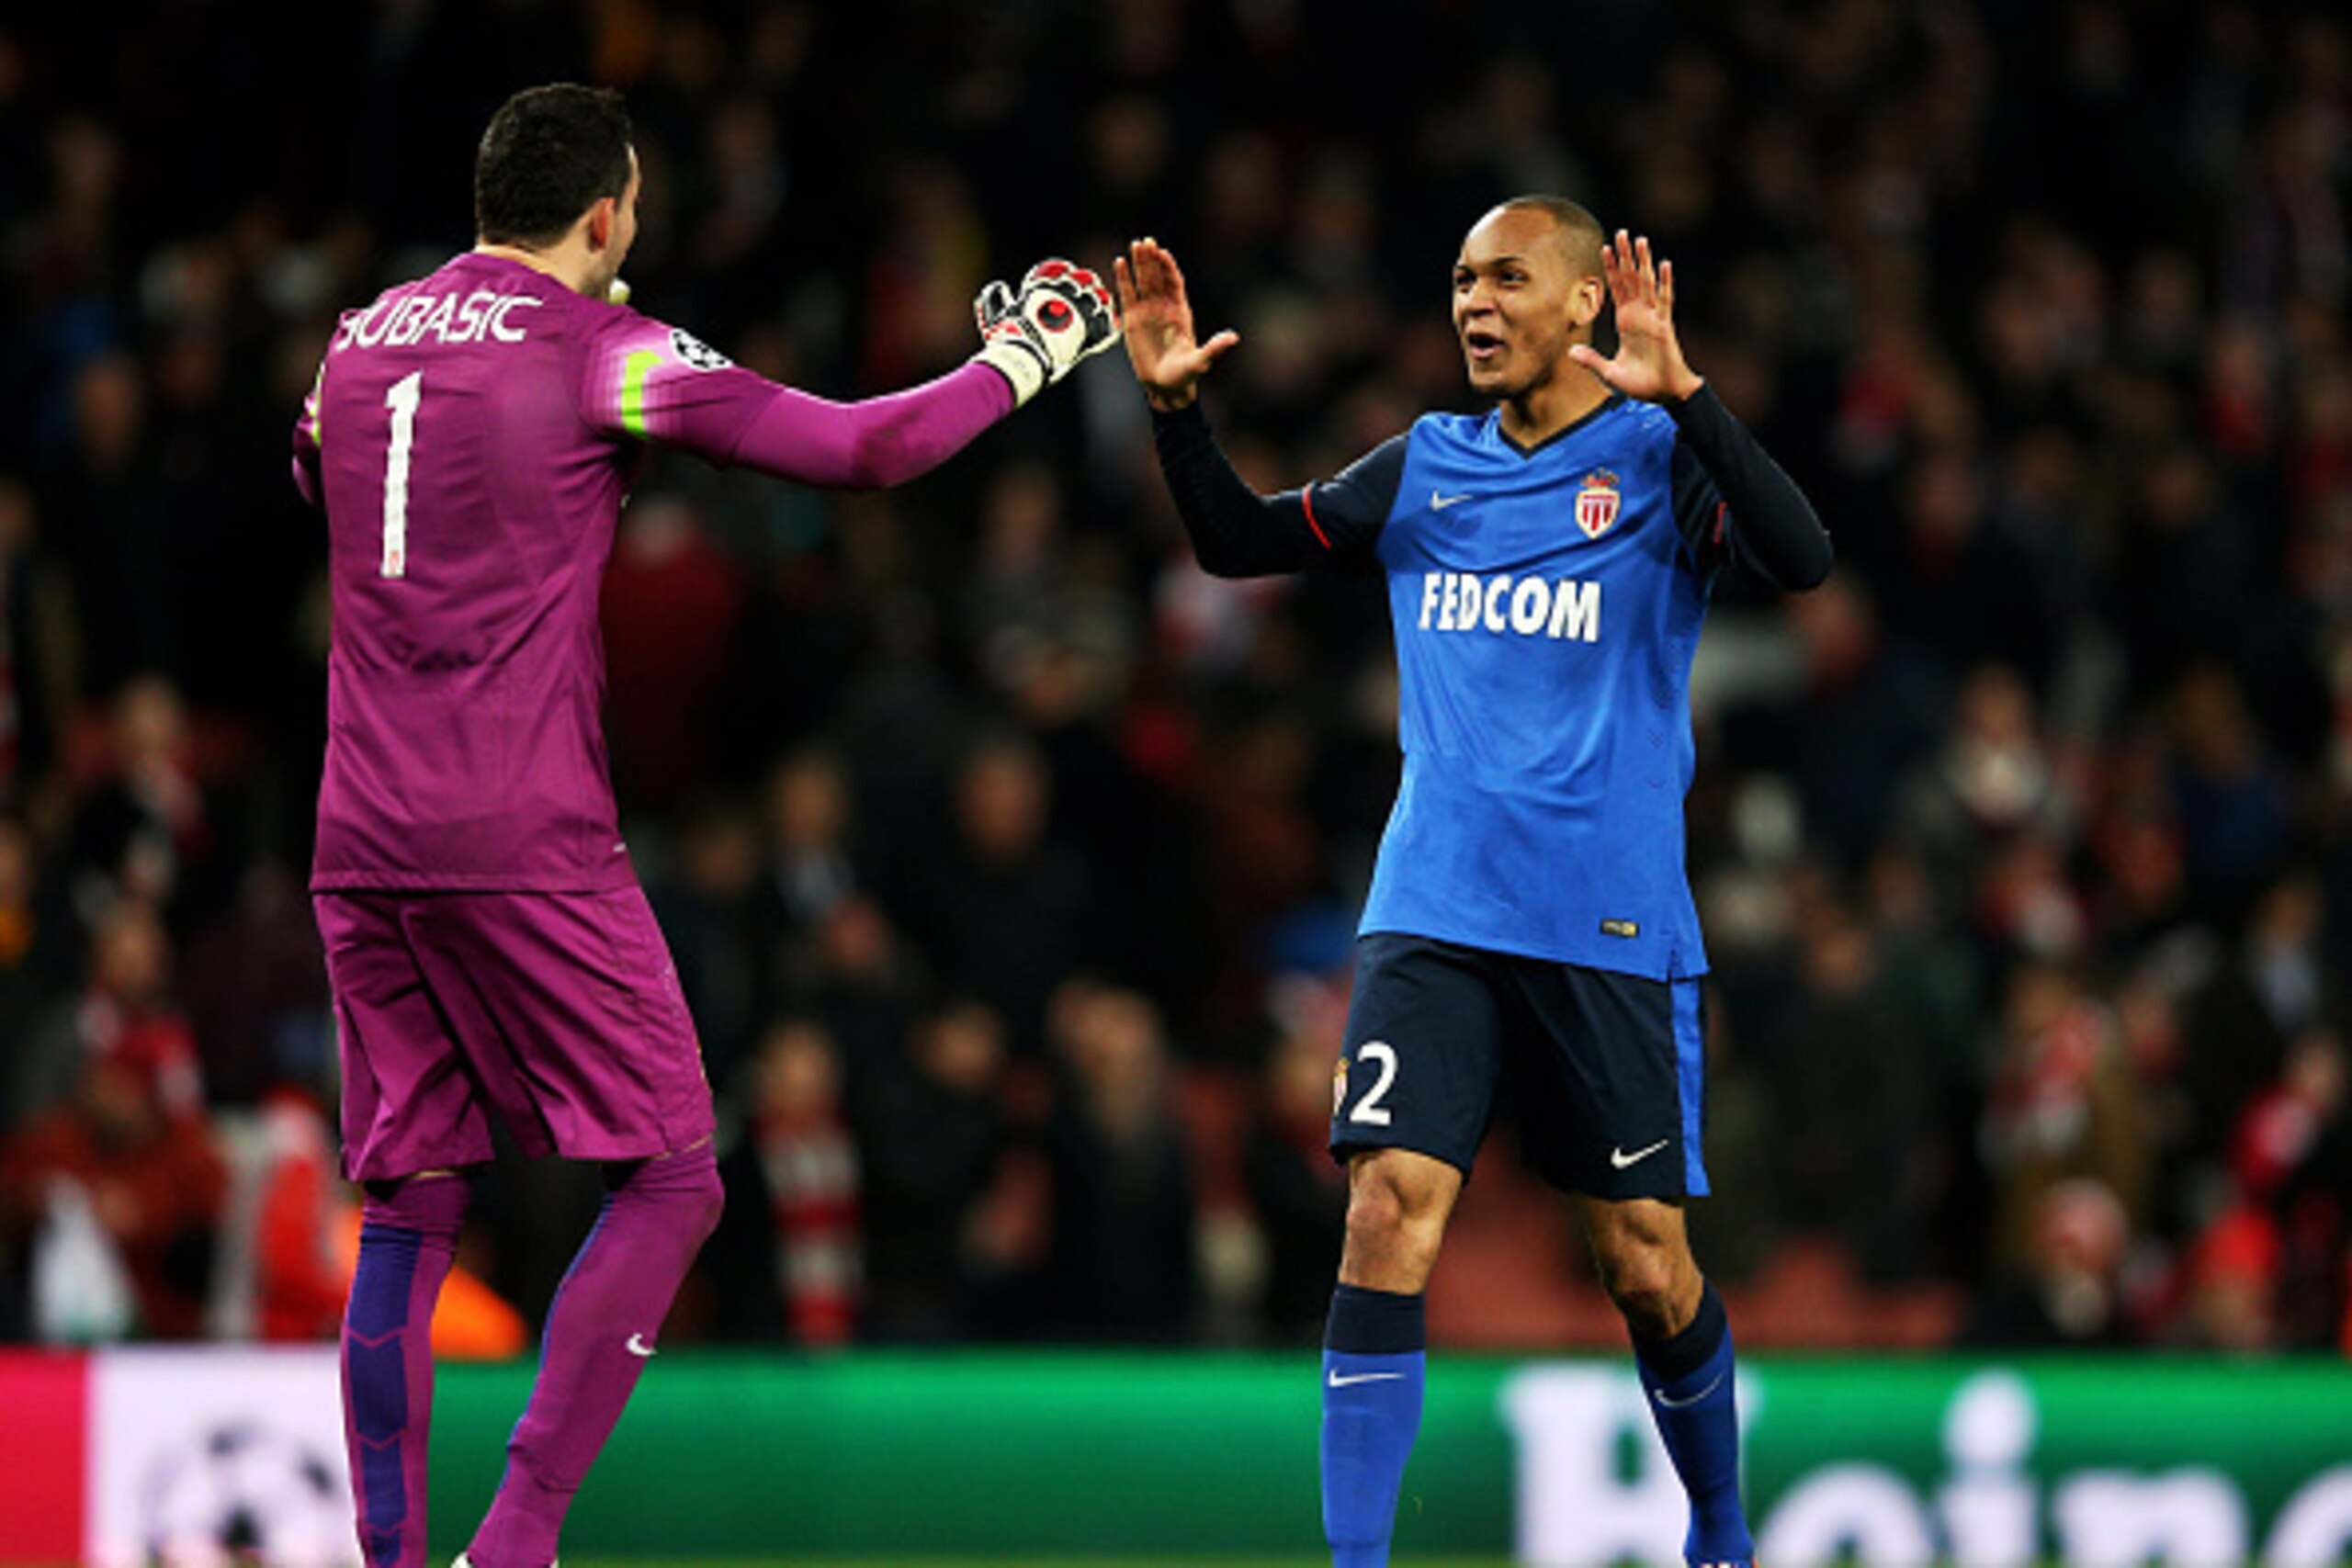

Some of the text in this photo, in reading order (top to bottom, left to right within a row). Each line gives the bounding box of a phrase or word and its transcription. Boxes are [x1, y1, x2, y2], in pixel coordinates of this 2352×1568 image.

[380, 371, 424, 579] 1
[1418, 571, 1601, 643] FEDCOM
[1349, 1041, 1398, 1126] 2
